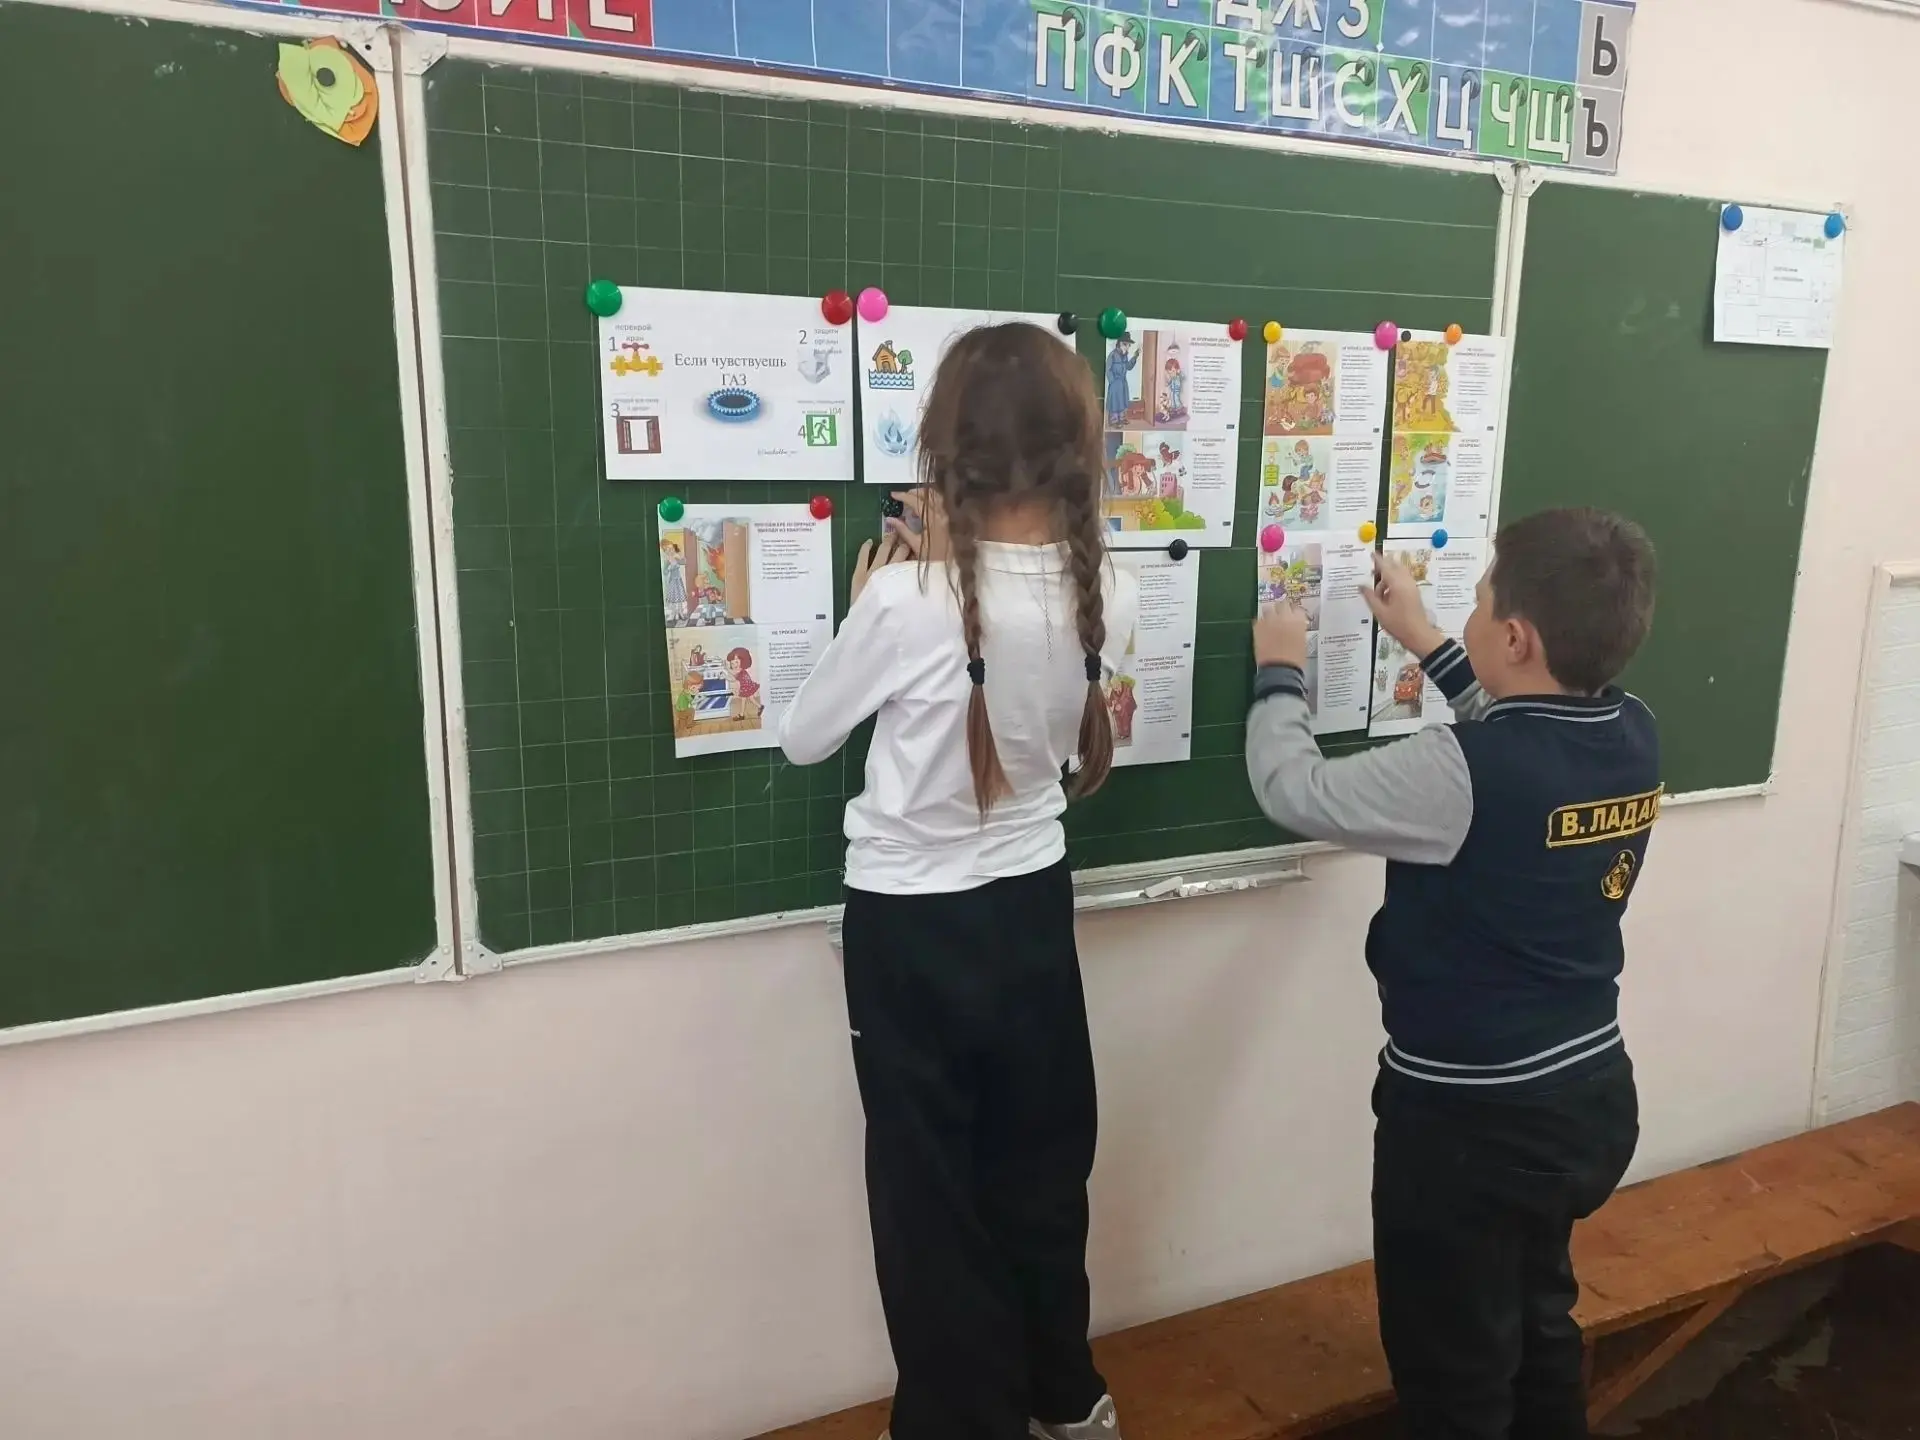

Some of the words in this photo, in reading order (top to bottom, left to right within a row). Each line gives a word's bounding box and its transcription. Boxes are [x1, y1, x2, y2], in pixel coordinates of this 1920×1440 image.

[1035, 11, 1077, 91] П
[1093, 24, 1141, 98] Ф
[1158, 34, 1199, 108] К
[1223, 42, 1260, 112] Т
[1272, 49, 1320, 120] Ш
[1333, 60, 1369, 128] С
[1384, 67, 1421, 135] Х
[1436, 76, 1472, 150] Ц
[1491, 82, 1518, 148] Ч
[1527, 89, 1571, 163] Щ
[609, 336, 618, 351] 1
[798, 329, 807, 345] 2
[674, 353, 707, 366] Если
[712, 357, 787, 370] чувствуешь
[721, 373, 747, 386] ГАЗ
[611, 403, 620, 418] 3
[798, 425, 806, 439] 4
